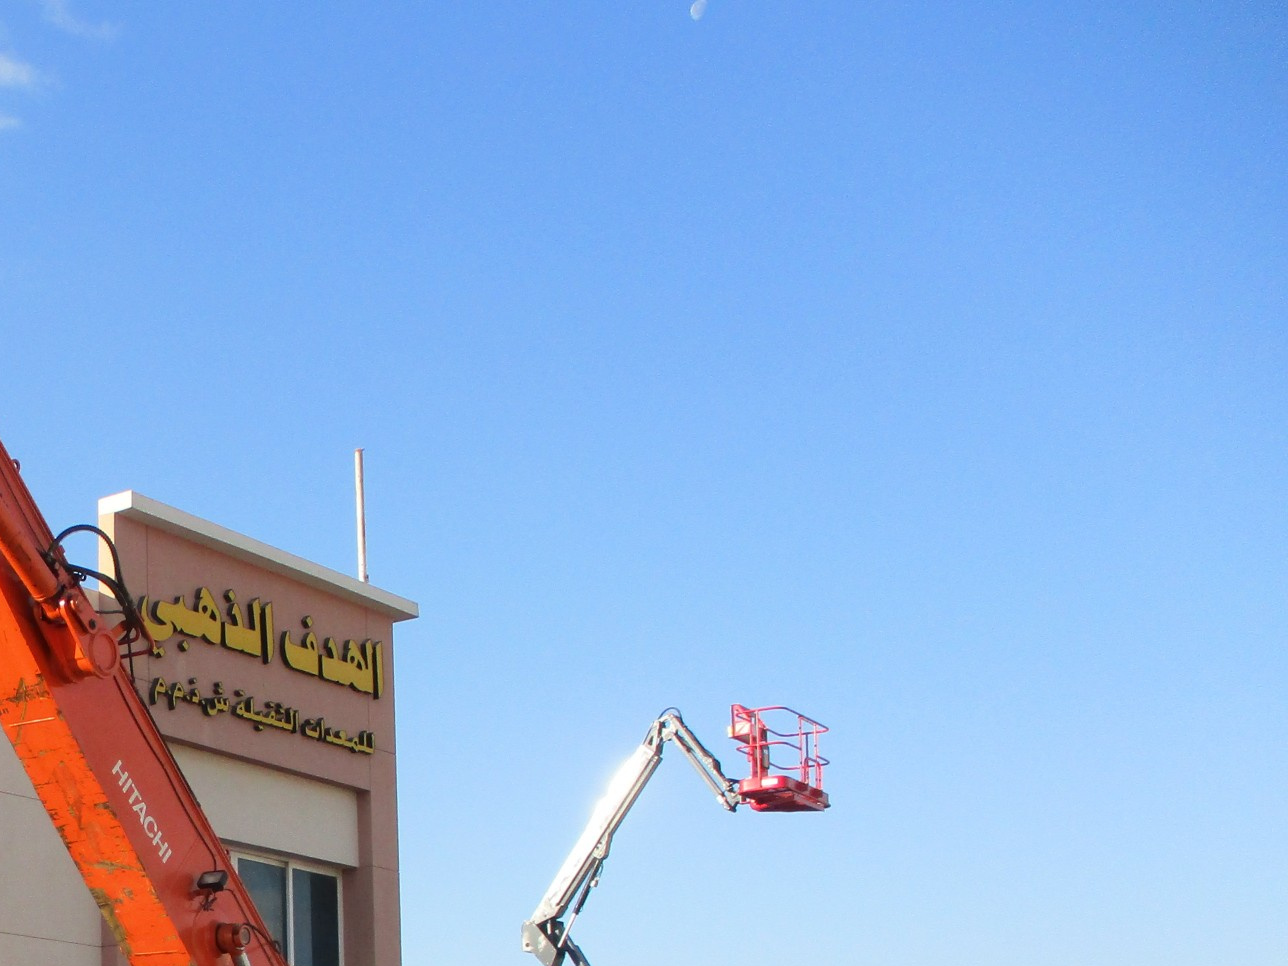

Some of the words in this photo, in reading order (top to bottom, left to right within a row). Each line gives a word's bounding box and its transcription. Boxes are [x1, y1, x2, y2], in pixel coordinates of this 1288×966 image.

[138, 585, 275, 665] الذهبي
[280, 614, 384, 700] الهدف
[231, 688, 299, 734] الثقيلة
[301, 717, 375, 755] للمعدات
[112, 759, 172, 864] HITACHI
